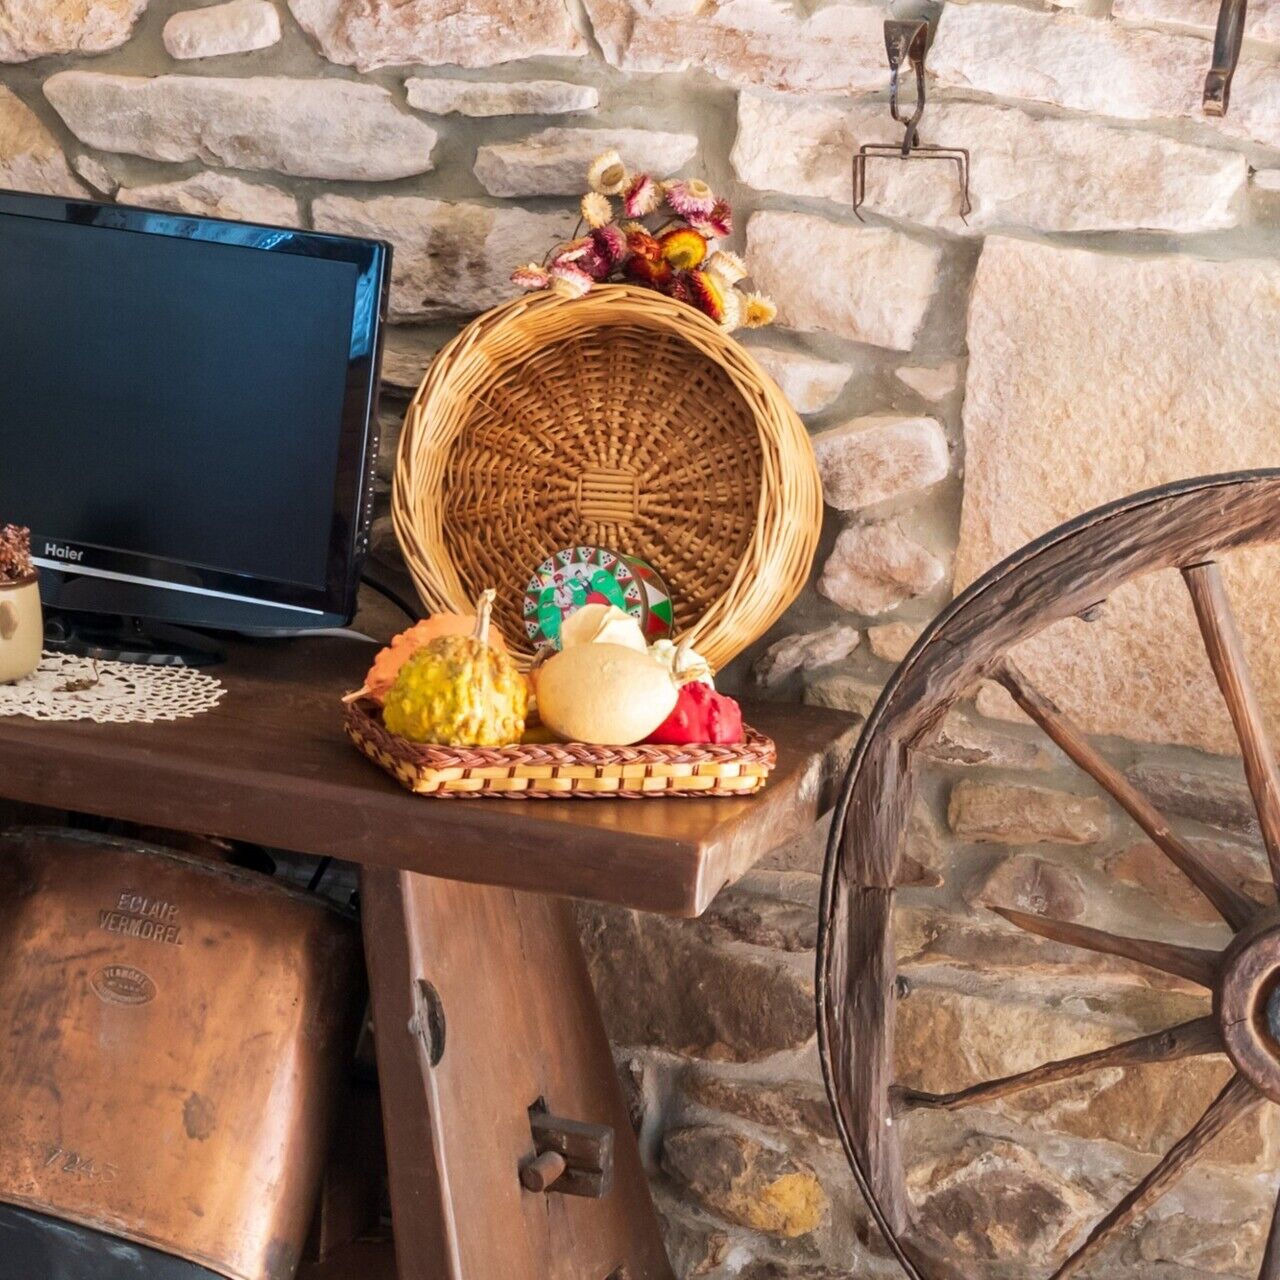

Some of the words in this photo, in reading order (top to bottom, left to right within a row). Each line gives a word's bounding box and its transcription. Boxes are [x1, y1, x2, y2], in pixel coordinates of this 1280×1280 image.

[45, 543, 83, 560] Haier
[118, 893, 180, 923] ECLAIR
[99, 910, 183, 946] VERMOREL
